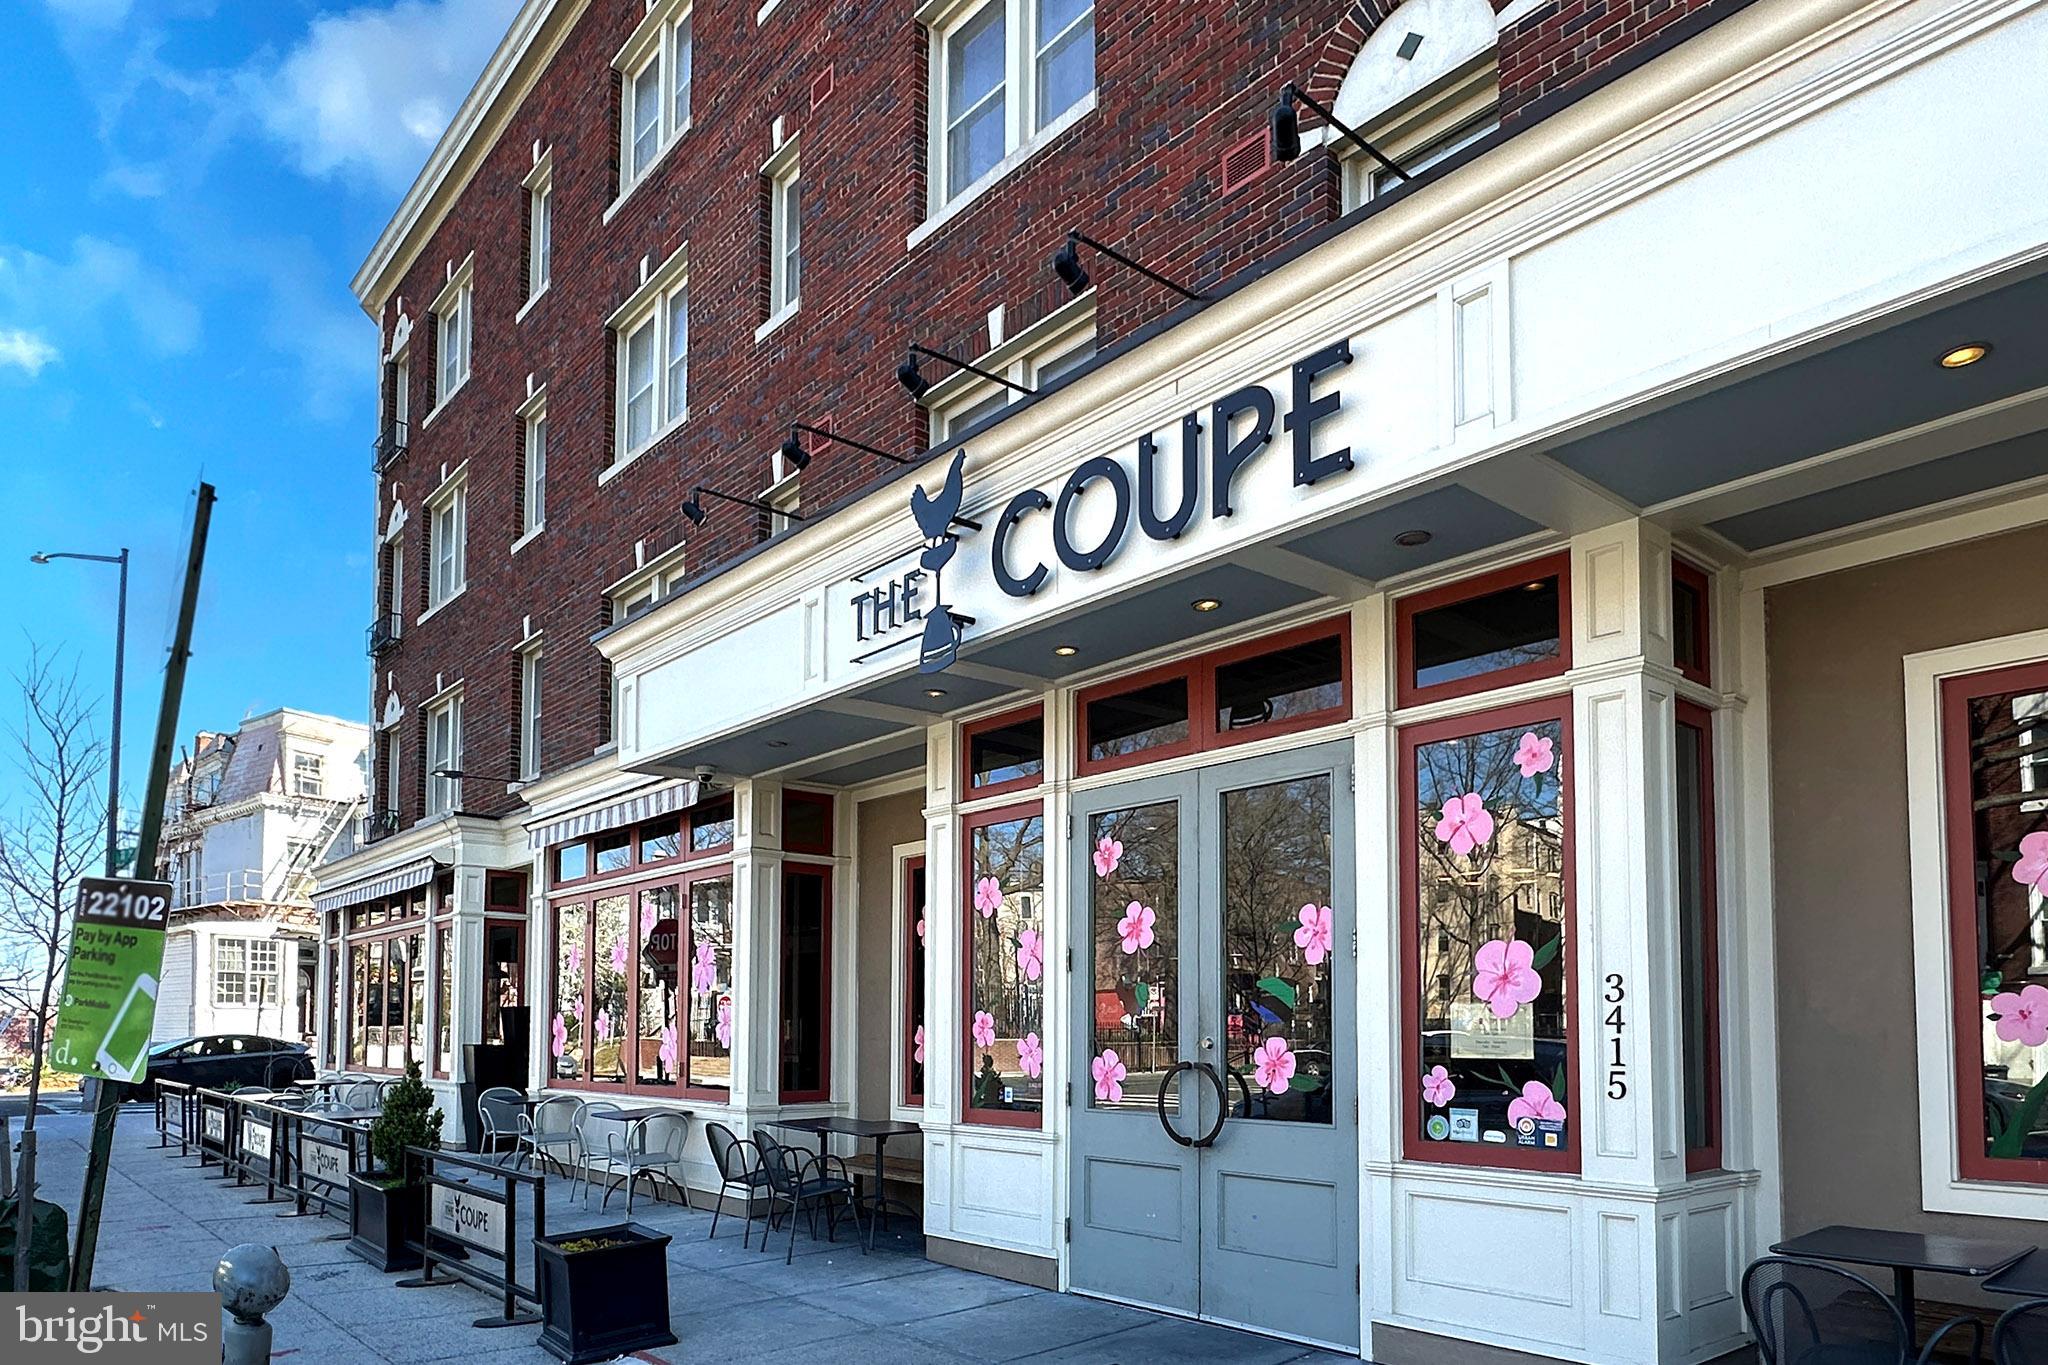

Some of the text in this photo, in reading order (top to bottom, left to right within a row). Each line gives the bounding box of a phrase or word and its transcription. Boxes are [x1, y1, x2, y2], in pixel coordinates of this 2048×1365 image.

[851, 338, 1352, 641] THE COUPE
[88, 891, 165, 921] 22102
[76, 928, 138, 948] Pay by App
[72, 946, 116, 966] Parking
[1604, 974, 1627, 1100] 3415
[321, 1153, 339, 1173] COUPE
[460, 1205, 488, 1232] COUPE
